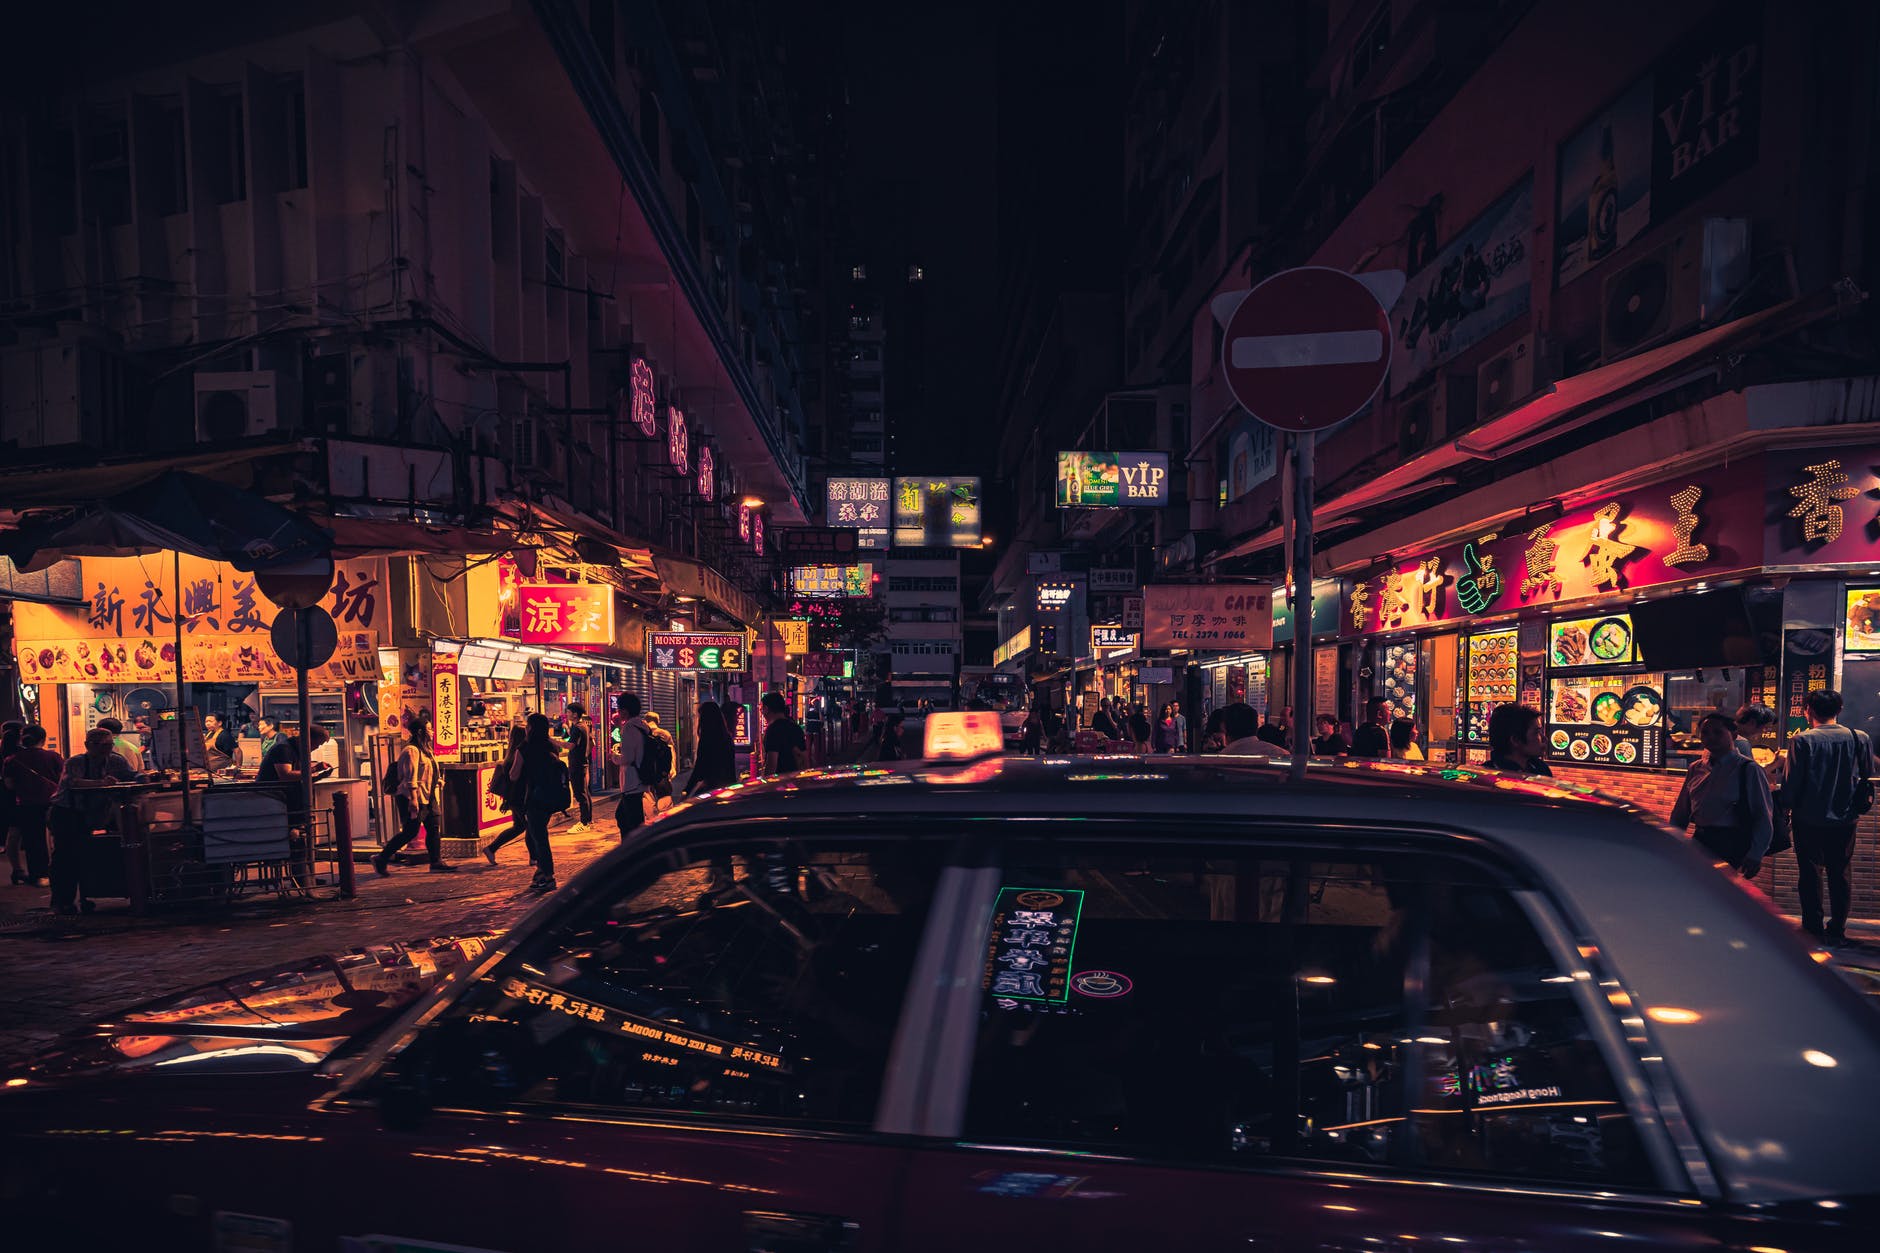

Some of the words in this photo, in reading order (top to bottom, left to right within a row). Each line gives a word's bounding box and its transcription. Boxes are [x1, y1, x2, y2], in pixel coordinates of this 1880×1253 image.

[1659, 44, 1757, 145] VIP
[1670, 108, 1740, 180] BAR
[1121, 466, 1165, 485] VIP
[829, 481, 888, 500] 浴潮流
[1128, 485, 1158, 498] BAR
[1786, 459, 1880, 543] 香
[838, 502, 879, 522] 桑拿
[88, 570, 379, 637] 新永興美坊
[1225, 595, 1266, 610] CAFE
[525, 596, 602, 633] 涼茶
[1170, 614, 1247, 627] 阿摩咖啡
[654, 636, 688, 645] MONEY
[690, 636, 740, 646] EXCHANGE
[1223, 631, 1246, 640] 1066
[1790, 670, 1805, 717] 全日供應
[439, 678, 454, 740] 香港涼茶
